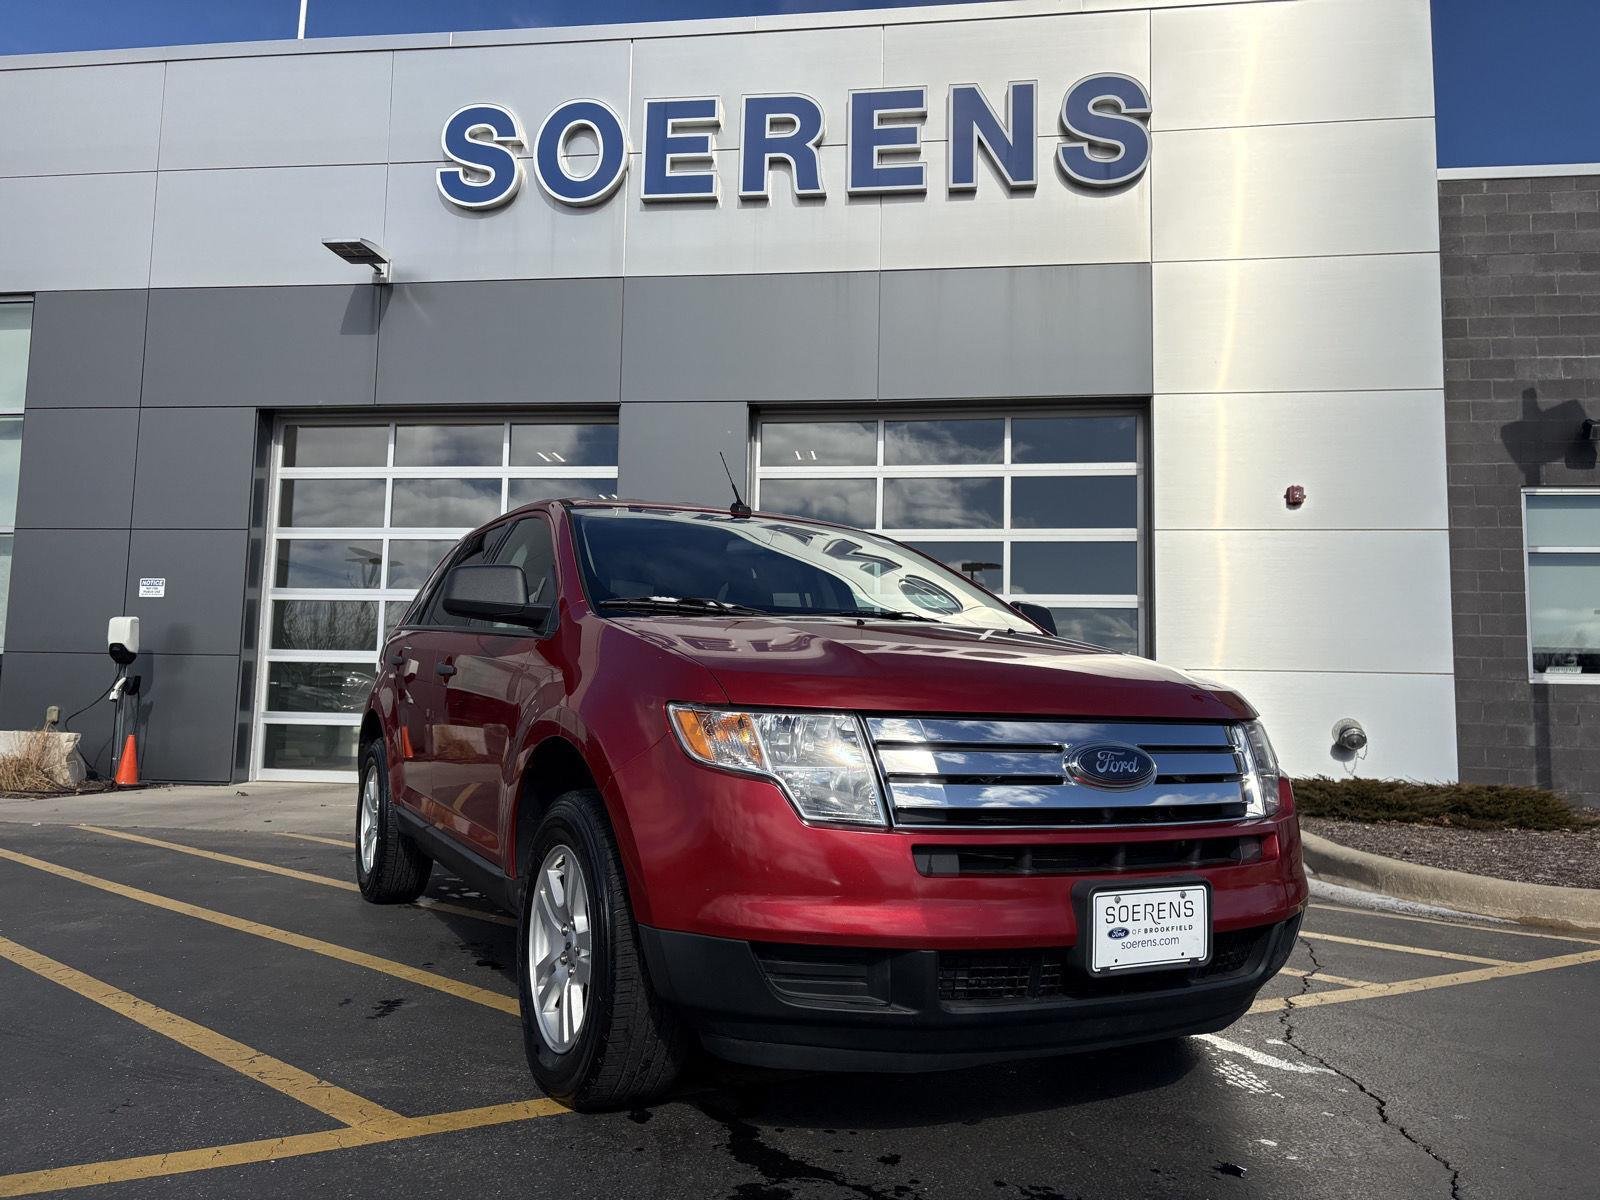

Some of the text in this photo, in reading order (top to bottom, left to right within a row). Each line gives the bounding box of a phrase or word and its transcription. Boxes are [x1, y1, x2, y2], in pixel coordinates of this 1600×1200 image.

[435, 72, 1152, 207] SOERENS
[1095, 750, 1140, 773] Ford
[1105, 900, 1195, 925] SOERENS
[1143, 924, 1194, 934] BROOKFIELD
[1121, 936, 1180, 950] soerens.com
